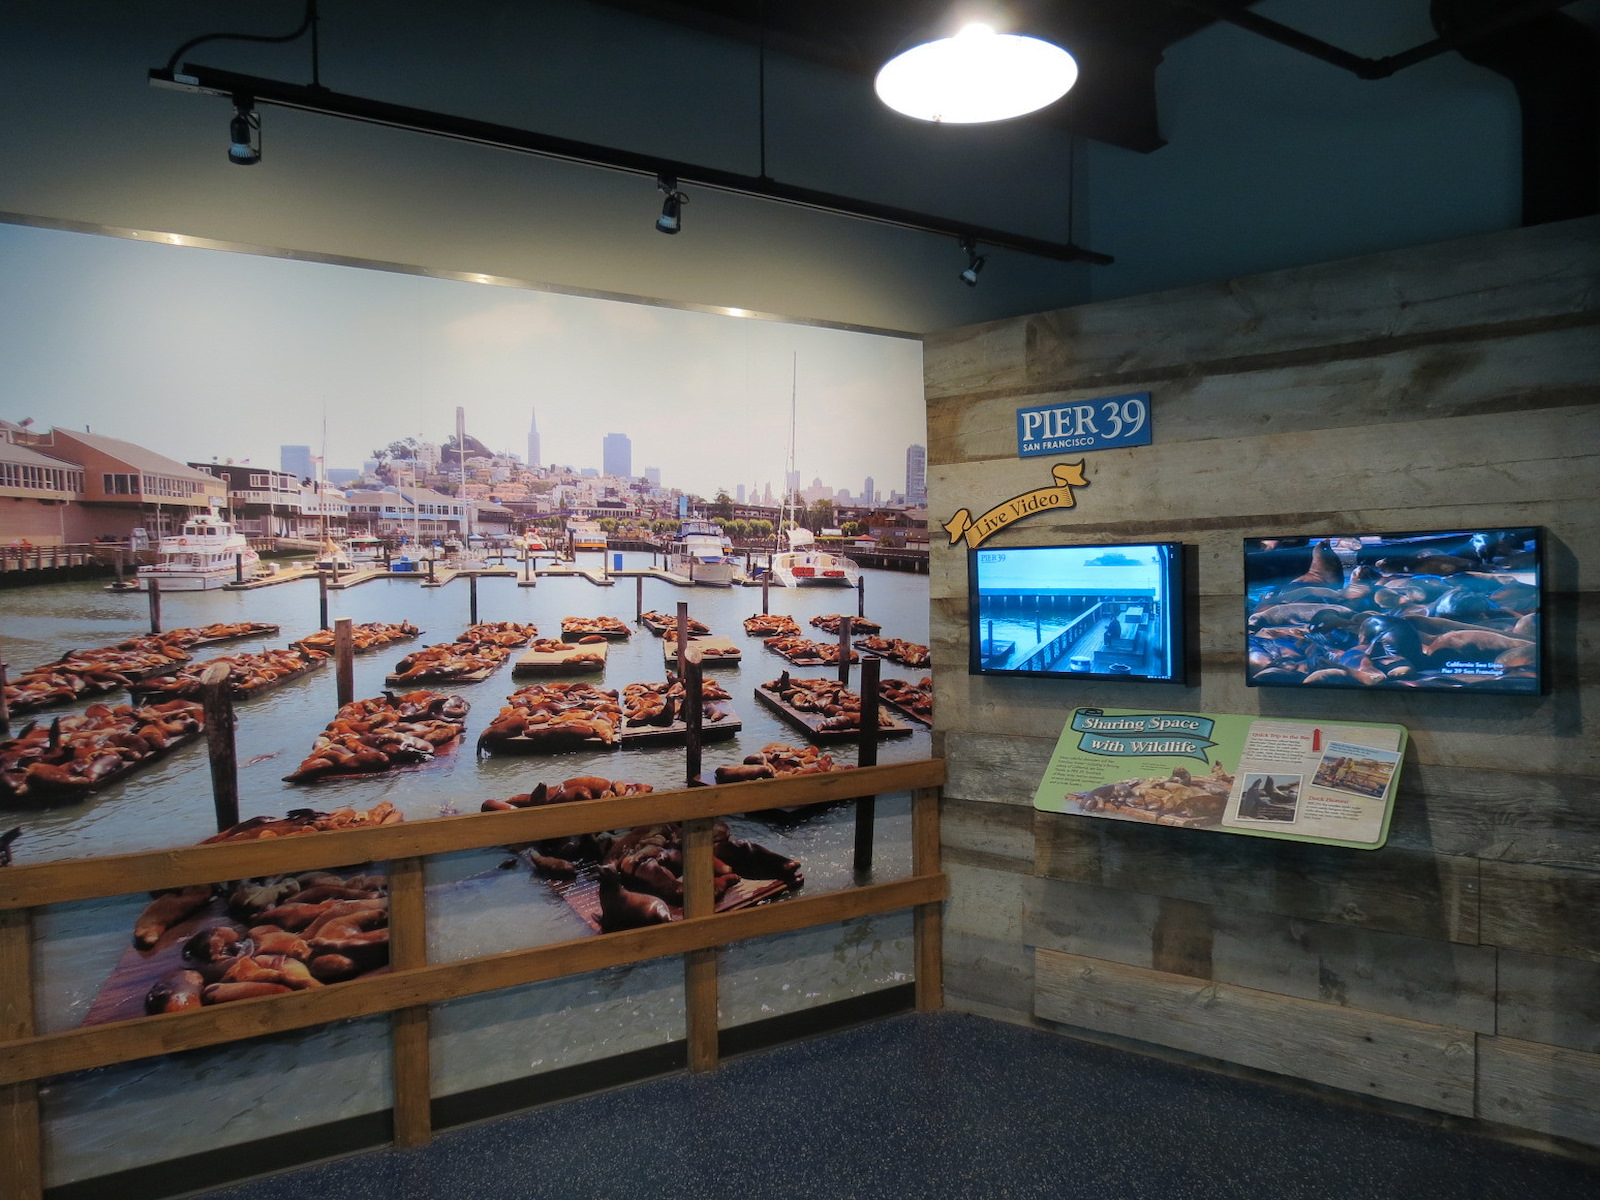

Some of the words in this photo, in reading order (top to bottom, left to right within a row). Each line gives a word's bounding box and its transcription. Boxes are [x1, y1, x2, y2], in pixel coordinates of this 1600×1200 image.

[1021, 405, 1099, 441] PIER
[1100, 399, 1146, 439] 39
[1022, 442, 1040, 452] SAN
[1042, 436, 1095, 451] FRANCISCO
[973, 512, 1009, 539] Live
[1009, 494, 1059, 516] Video
[1081, 717, 1145, 732] Sharing
[1148, 717, 1199, 731] Space
[1091, 740, 1125, 752] with
[1130, 740, 1197, 753] Wildlife
